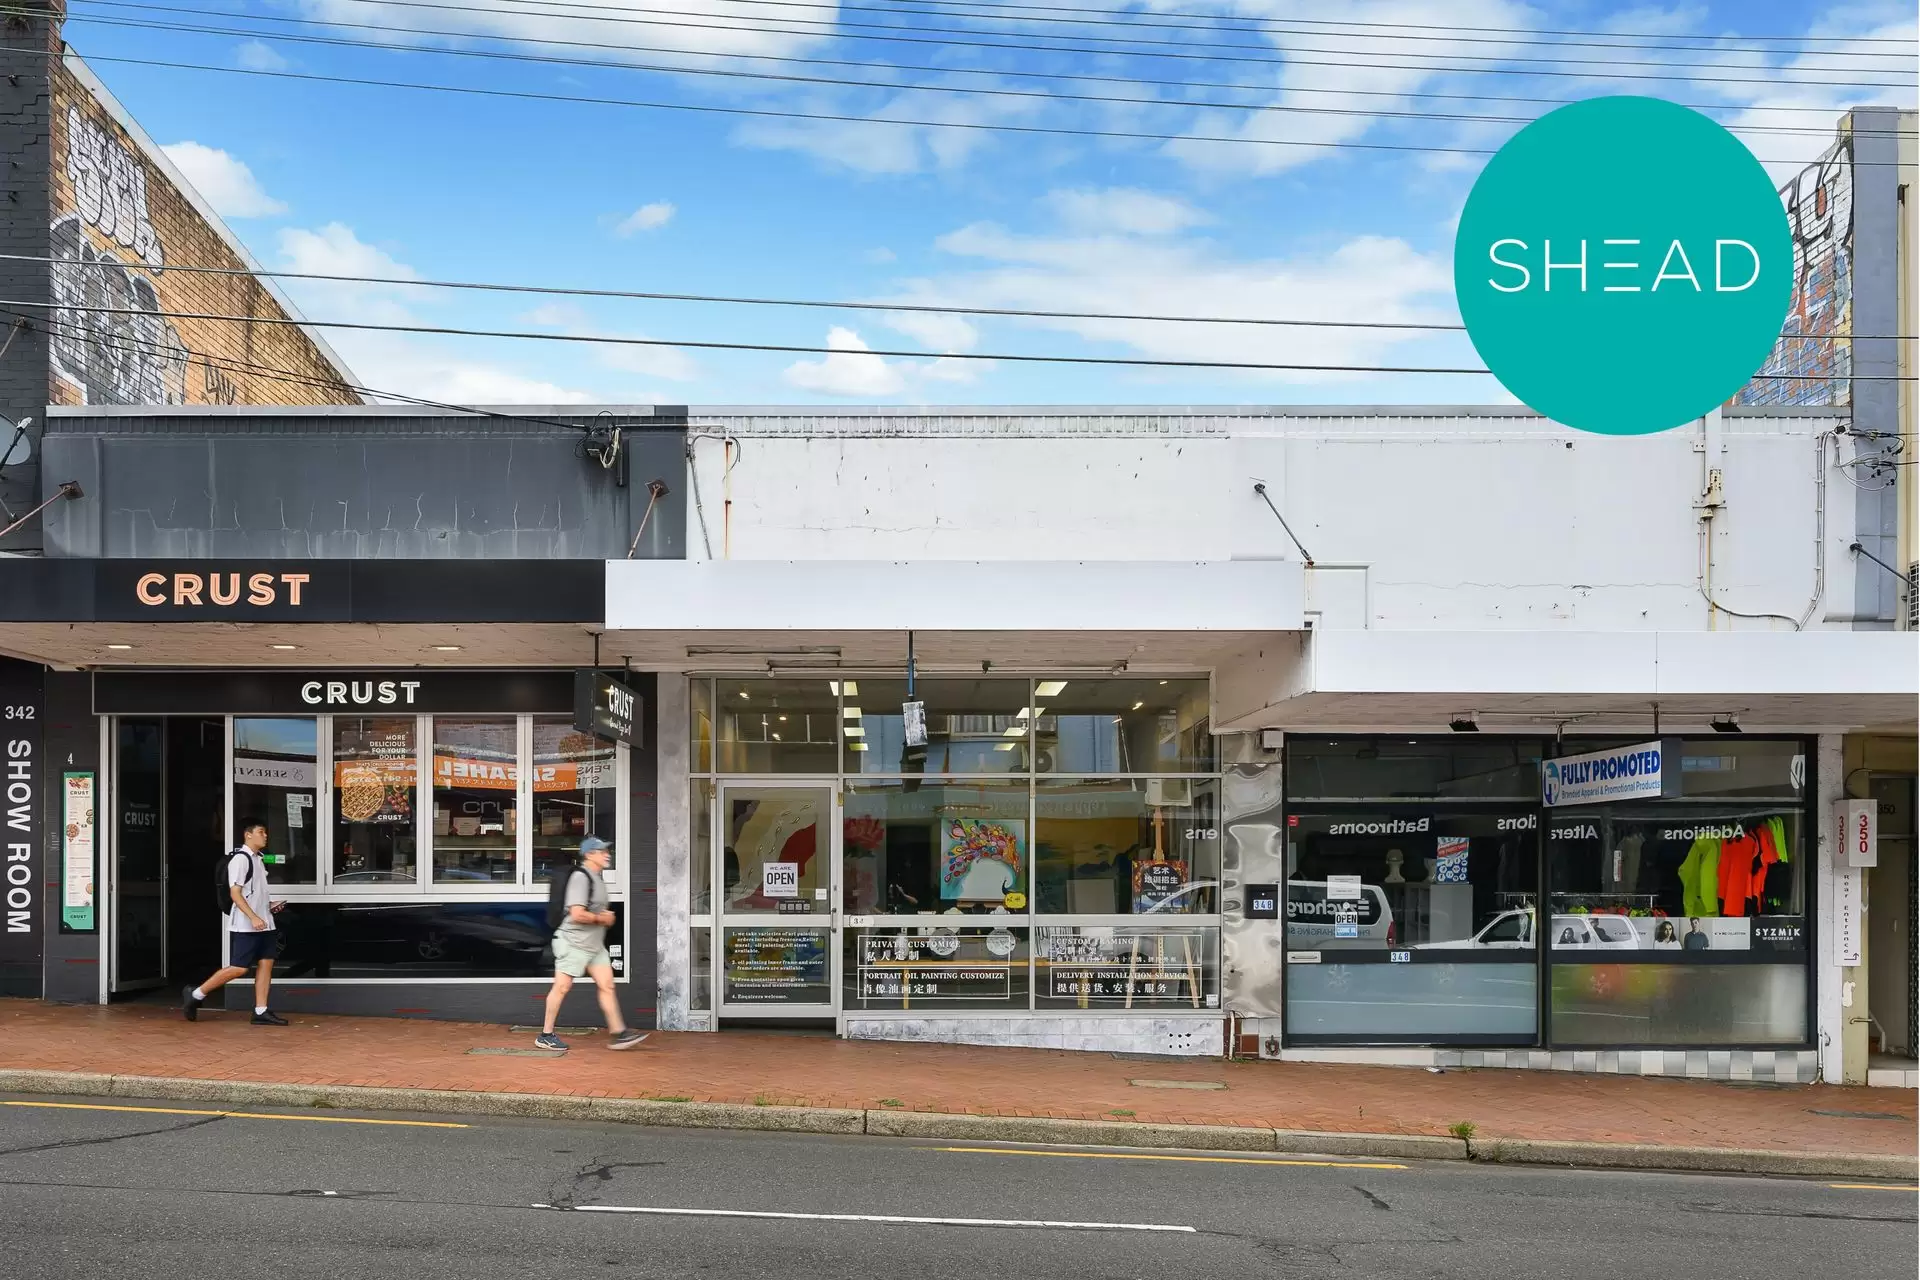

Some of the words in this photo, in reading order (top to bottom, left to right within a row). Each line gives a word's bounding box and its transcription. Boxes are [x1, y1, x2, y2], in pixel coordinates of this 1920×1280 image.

[136, 573, 310, 606] CRUST
[301, 681, 420, 704] CRUST
[608, 684, 634, 721] CRUST
[5, 706, 35, 720] 342
[67, 753, 74, 764] 4
[1561, 761, 1591, 786] FULLY
[1592, 750, 1660, 782] PROMOTED
[7, 739, 32, 832] SHOW
[1581, 786, 1600, 799] Apparel
[1604, 782, 1636, 795] Promotional
[1636, 779, 1660, 791] Products
[1878, 804, 1895, 815] 350
[125, 811, 156, 826] CRUST
[1859, 815, 1868, 853] 350
[766, 872, 795, 885] OPEN
[7, 843, 32, 933] ROOM
[1254, 900, 1272, 909] 348
[1336, 914, 1357, 924] OPEN
[866, 951, 919, 961] 私人定制
[1392, 952, 1410, 961] 348
[864, 972, 903, 980] PORTRAIT
[904, 972, 918, 980] OIL
[921, 972, 958, 980] PAINTING
[960, 972, 1005, 980] CUSTOMIZE
